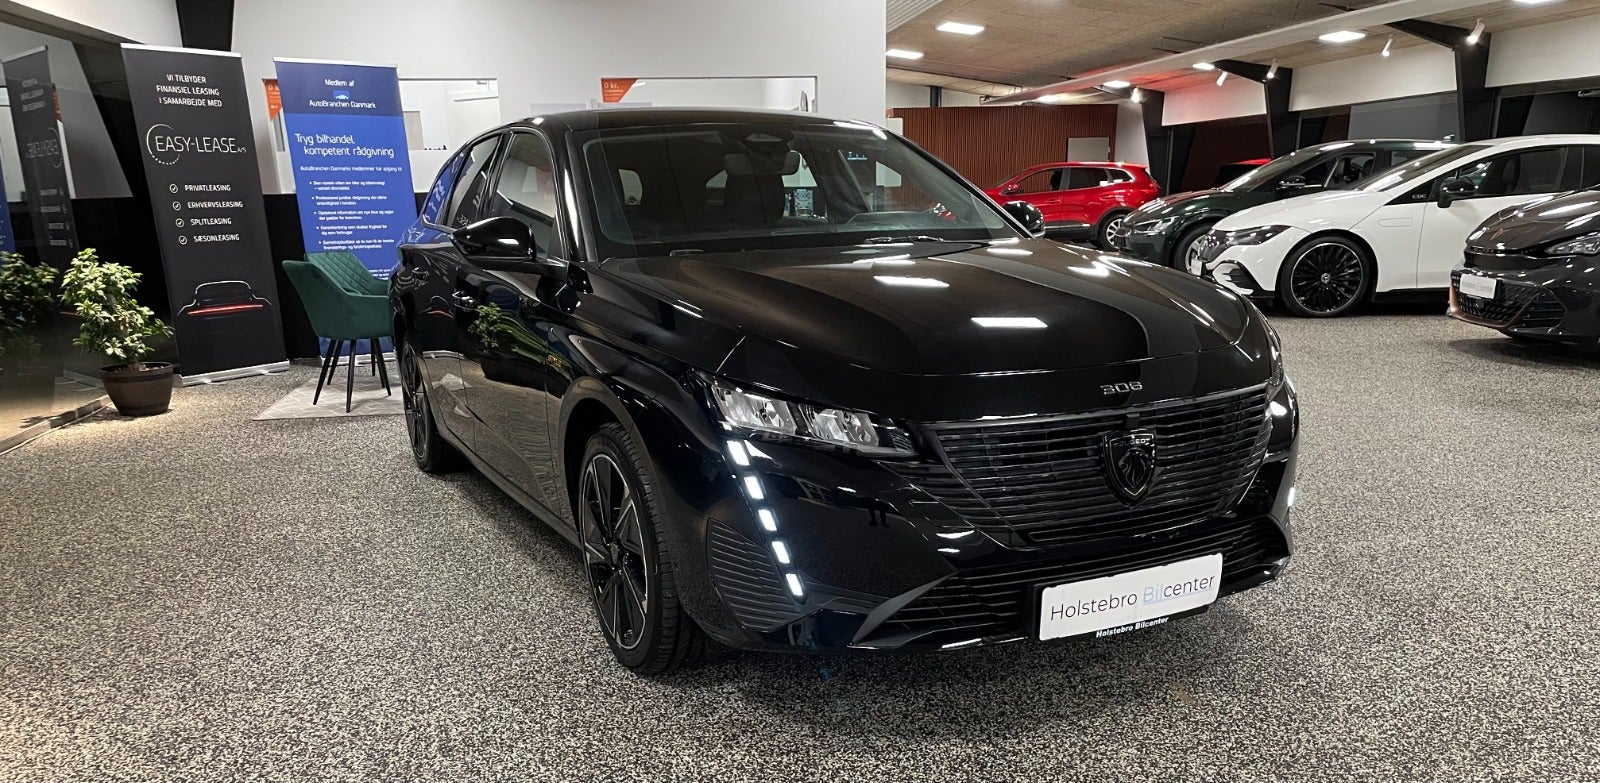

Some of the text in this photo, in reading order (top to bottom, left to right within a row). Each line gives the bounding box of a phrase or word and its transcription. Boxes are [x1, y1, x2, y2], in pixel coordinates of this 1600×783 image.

[175, 74, 207, 84] TILBYDER
[324, 79, 348, 87] Medlem
[156, 84, 220, 96] FINANSIEL LEASING
[162, 96, 206, 107] SAMARBEJDE
[207, 99, 223, 108] MED
[309, 99, 377, 109] AutoBranchen Danmark
[155, 136, 238, 153] EASY-LEASE
[294, 133, 356, 146] Tryg bilhandel,
[304, 146, 394, 158] kompetent rådgivning
[184, 184, 231, 192] PRIVATLEASING
[187, 201, 244, 209] ERHVERVSLEASING
[190, 218, 232, 226] SPLITLEASING
[193, 233, 240, 243] SÆSONLEASING
[1113, 438, 1150, 447] PGEOT
[1050, 575, 1215, 621] Holstebro Bilcenter
[1095, 616, 1170, 639] Holstebro Bilcenter
